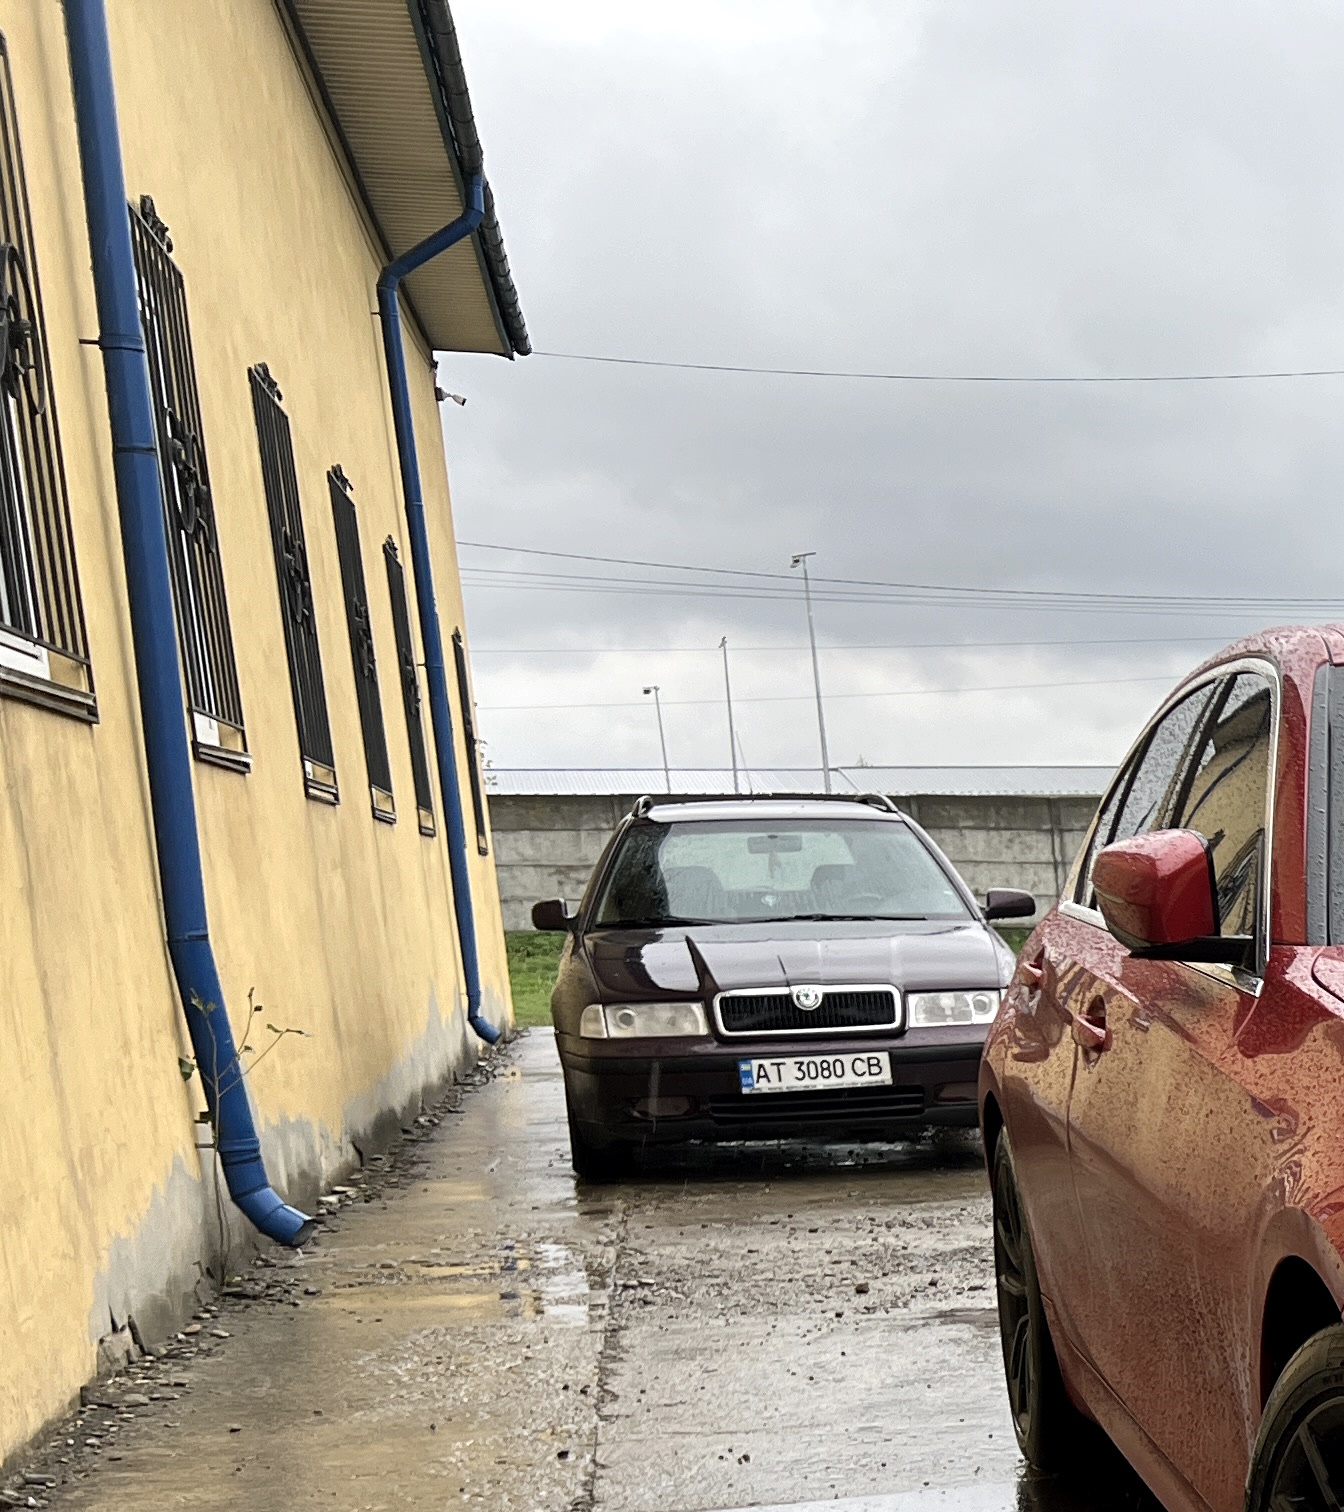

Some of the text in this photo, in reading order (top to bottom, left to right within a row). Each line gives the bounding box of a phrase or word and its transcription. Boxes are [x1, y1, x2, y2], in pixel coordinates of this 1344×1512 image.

[756, 1056, 883, 1084] AT 3080 CB
